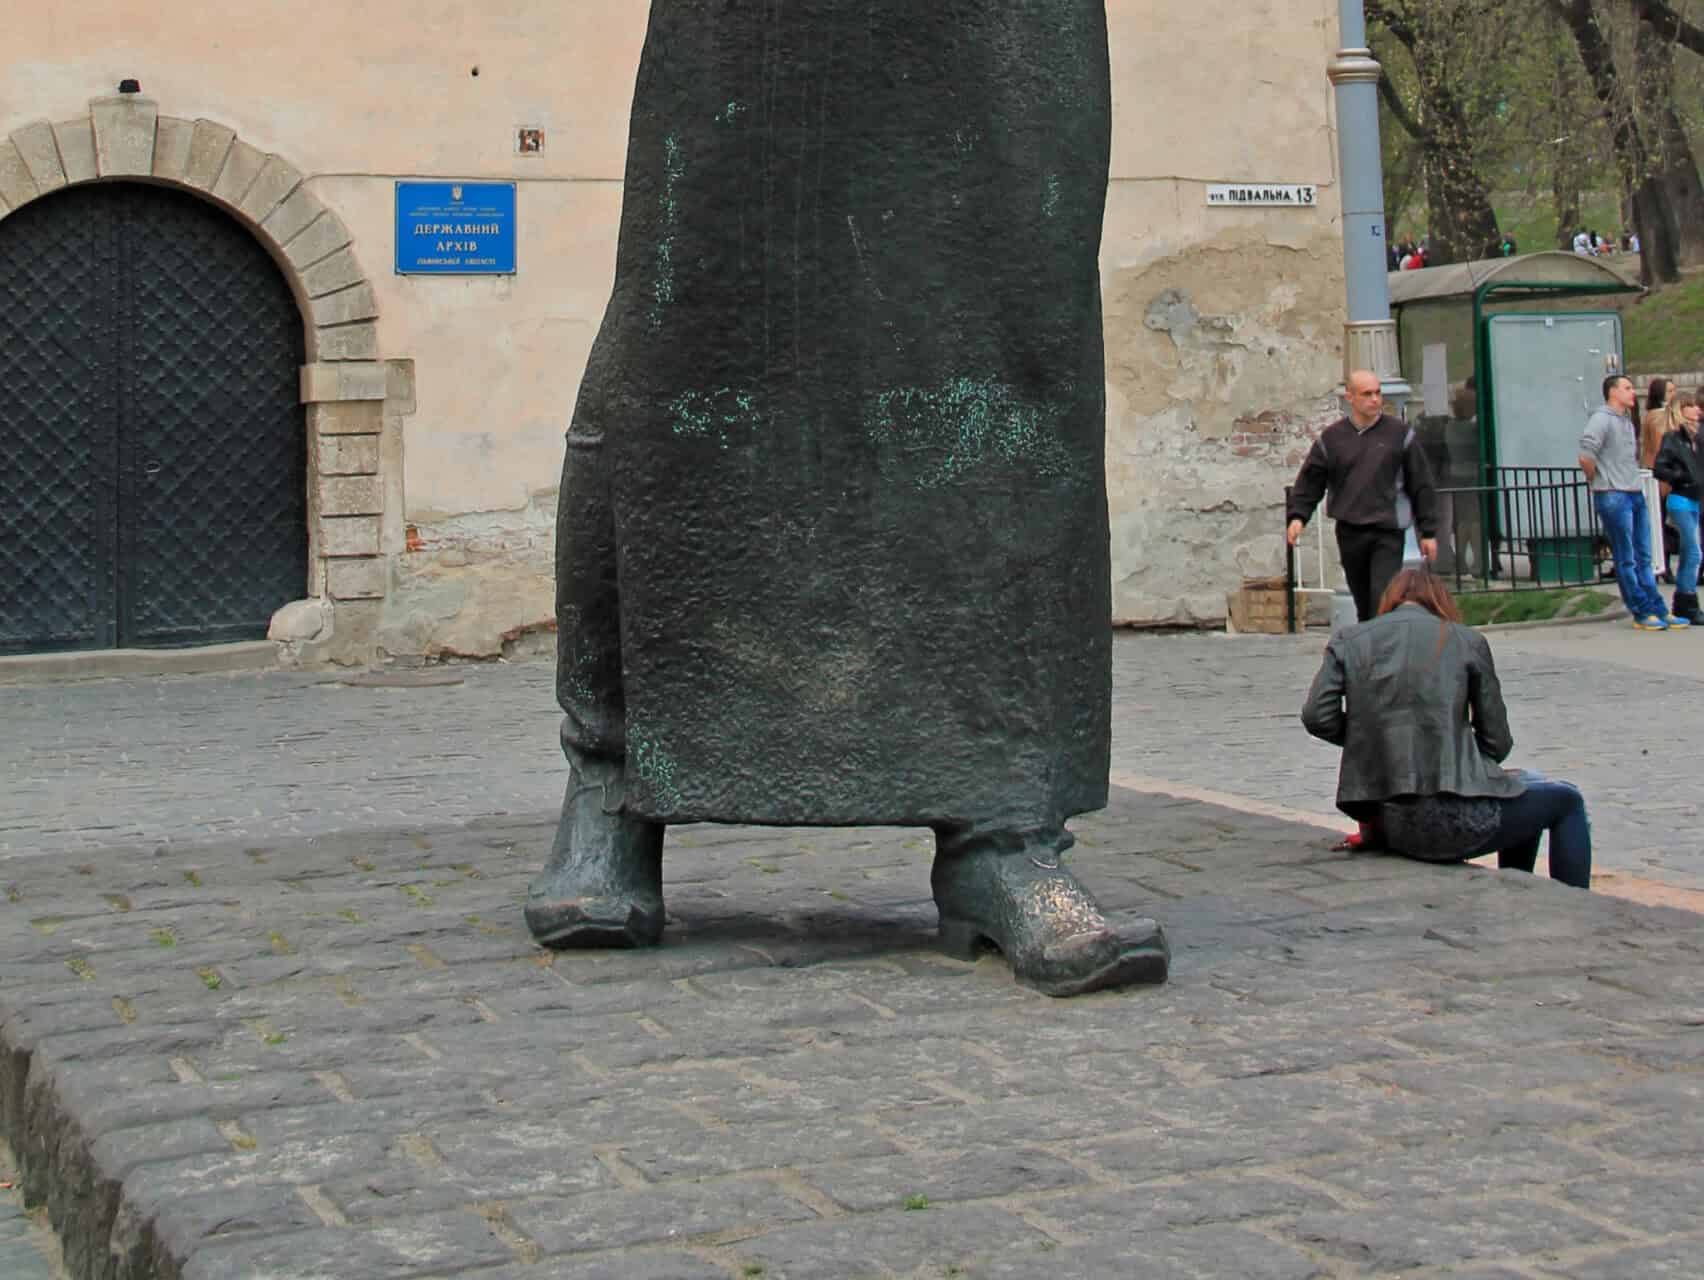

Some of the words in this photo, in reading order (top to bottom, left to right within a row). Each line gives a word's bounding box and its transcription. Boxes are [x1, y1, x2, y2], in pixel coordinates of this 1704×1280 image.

[1296, 187, 1313, 203] 13
[414, 223, 500, 235] ДЕРЖАВНИЙ
[436, 240, 478, 252] АРХІВ
